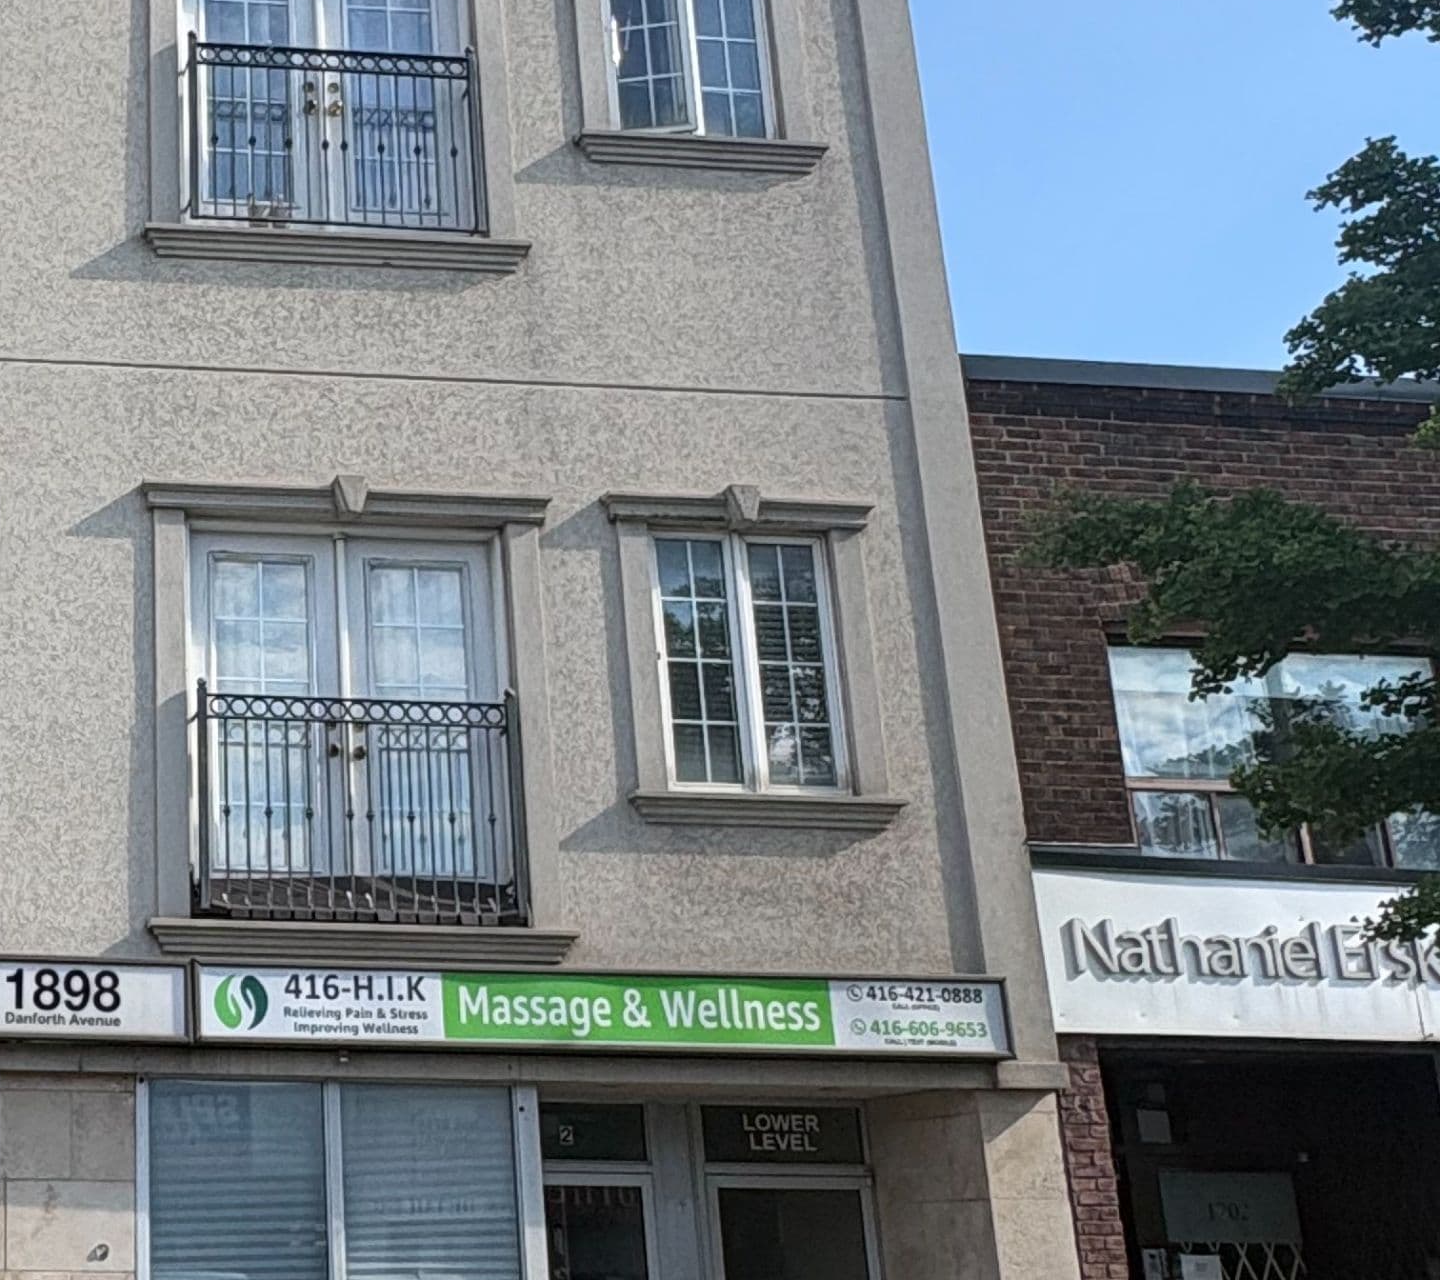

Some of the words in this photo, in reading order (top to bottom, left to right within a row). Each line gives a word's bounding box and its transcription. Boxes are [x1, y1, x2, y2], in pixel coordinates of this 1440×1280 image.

[1060, 917, 1326, 983] Nathaniel
[5, 968, 121, 1013] 1898
[284, 973, 426, 1002] 416-H.I.K
[866, 985, 983, 1004] 416-421-0888
[4, 1011, 66, 1026] Danforth
[69, 1013, 121, 1028] Avenue
[283, 1006, 341, 1020] Relieving
[345, 1007, 373, 1019] Pain
[377, 1007, 386, 1019] &
[390, 1008, 428, 1020] Stress
[459, 985, 611, 1037] Massage
[623, 988, 651, 1029] &
[660, 988, 821, 1031] Wellness
[294, 1022, 359, 1035] Improving
[363, 1023, 419, 1034] Wellness
[870, 1020, 988, 1038] 416-606-9653
[743, 1113, 820, 1133] LOWER
[749, 1132, 818, 1152] LEVEL
